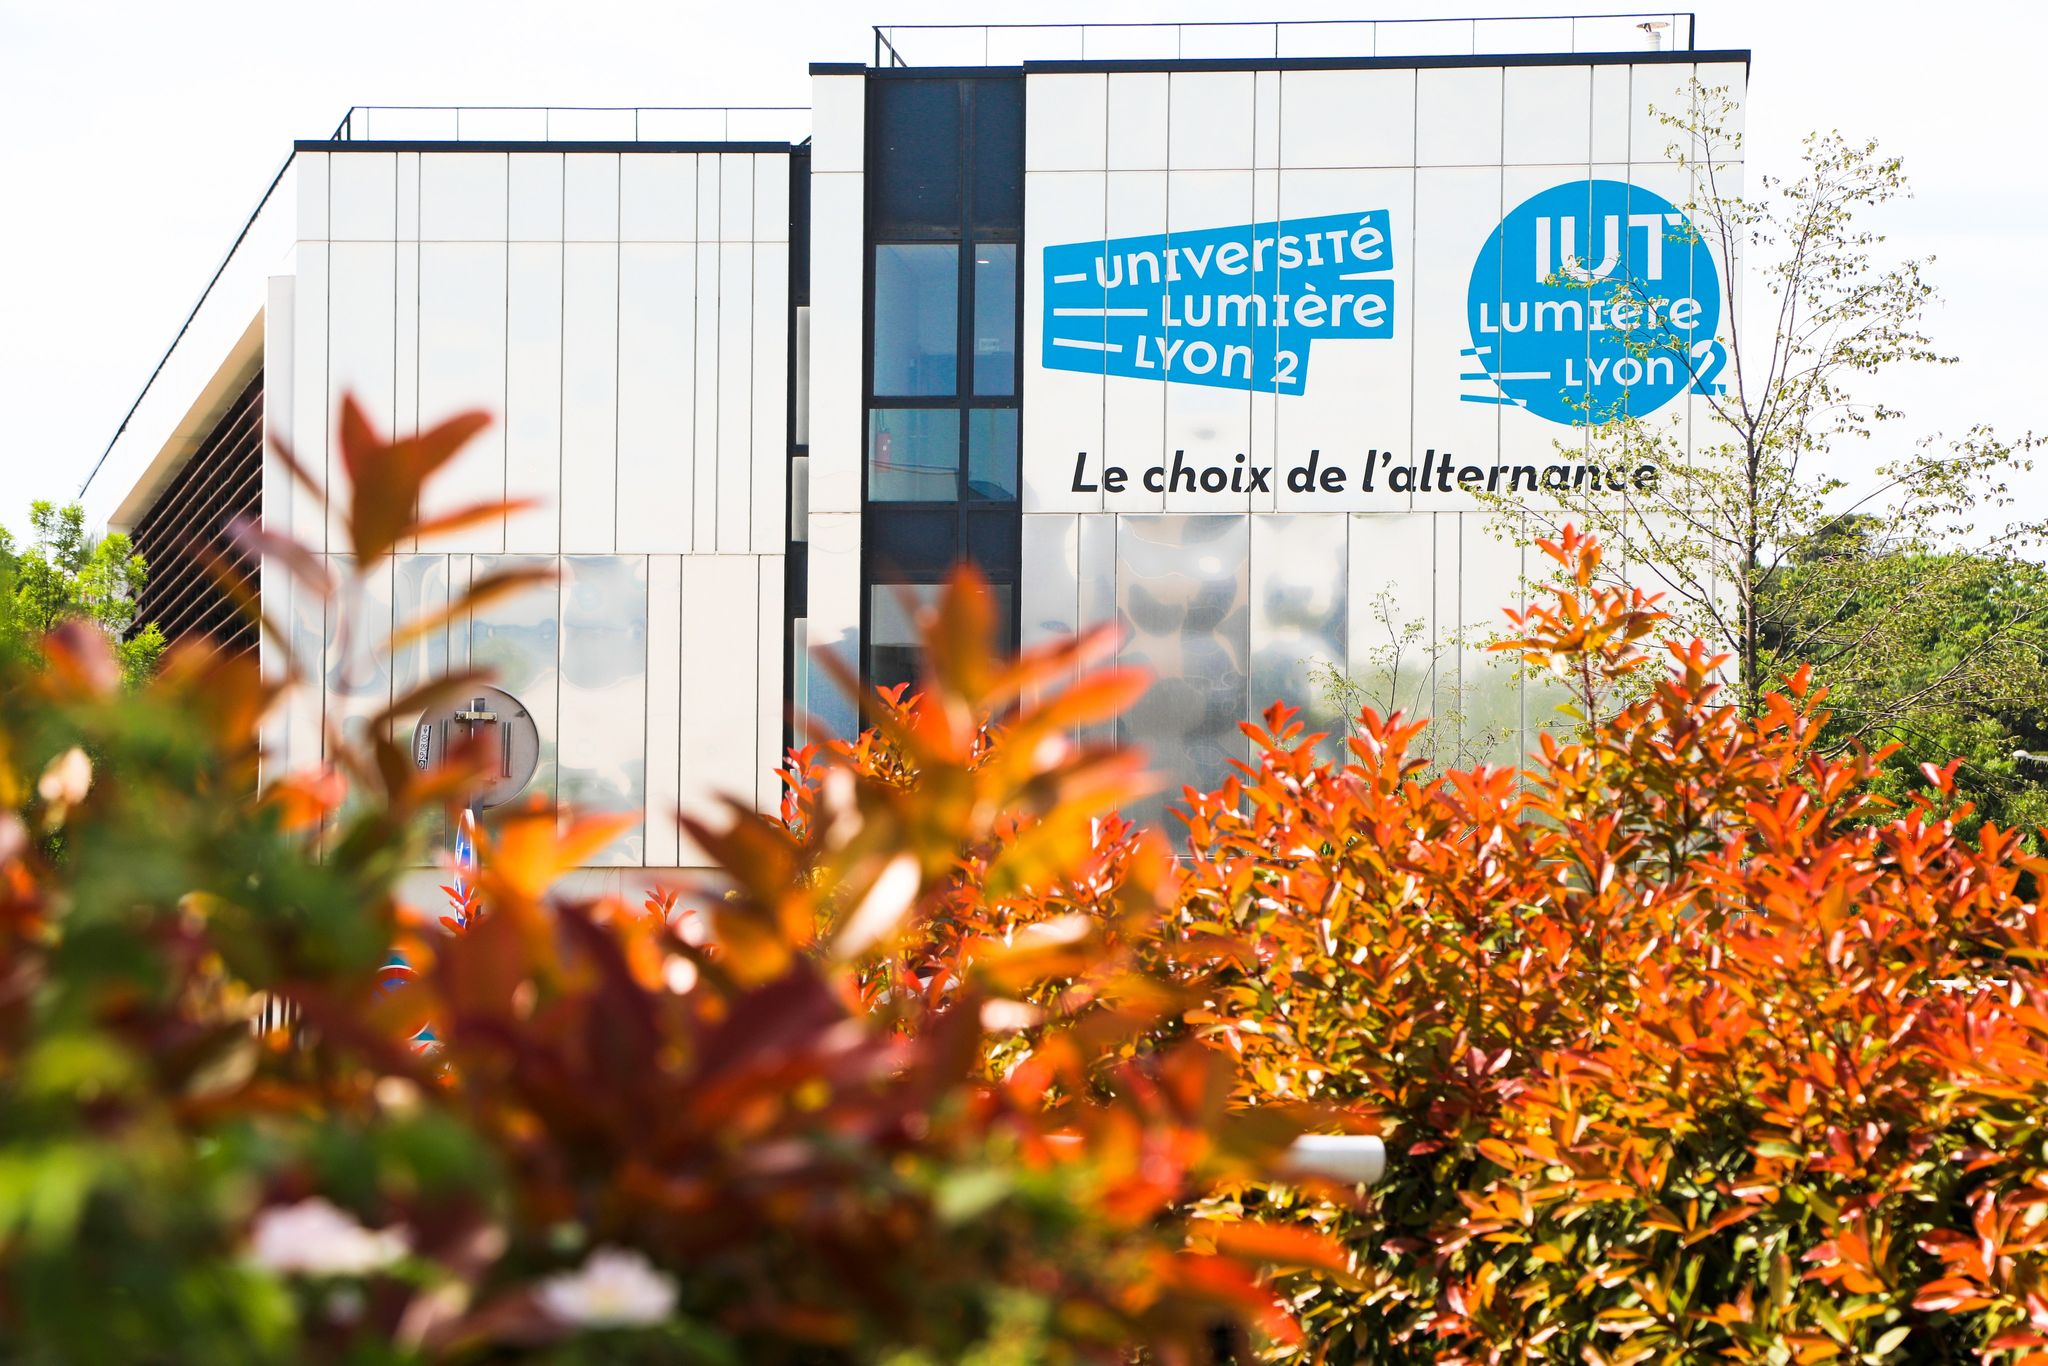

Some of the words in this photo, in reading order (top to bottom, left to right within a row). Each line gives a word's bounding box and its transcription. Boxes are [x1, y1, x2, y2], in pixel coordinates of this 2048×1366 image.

[1536, 213, 1683, 283] IUT
[1270, 350, 1299, 384] 2
[1690, 339, 1727, 396] 2
[1071, 451, 1128, 493] Le
[1143, 450, 1272, 493] choix
[1287, 450, 1346, 493] de
